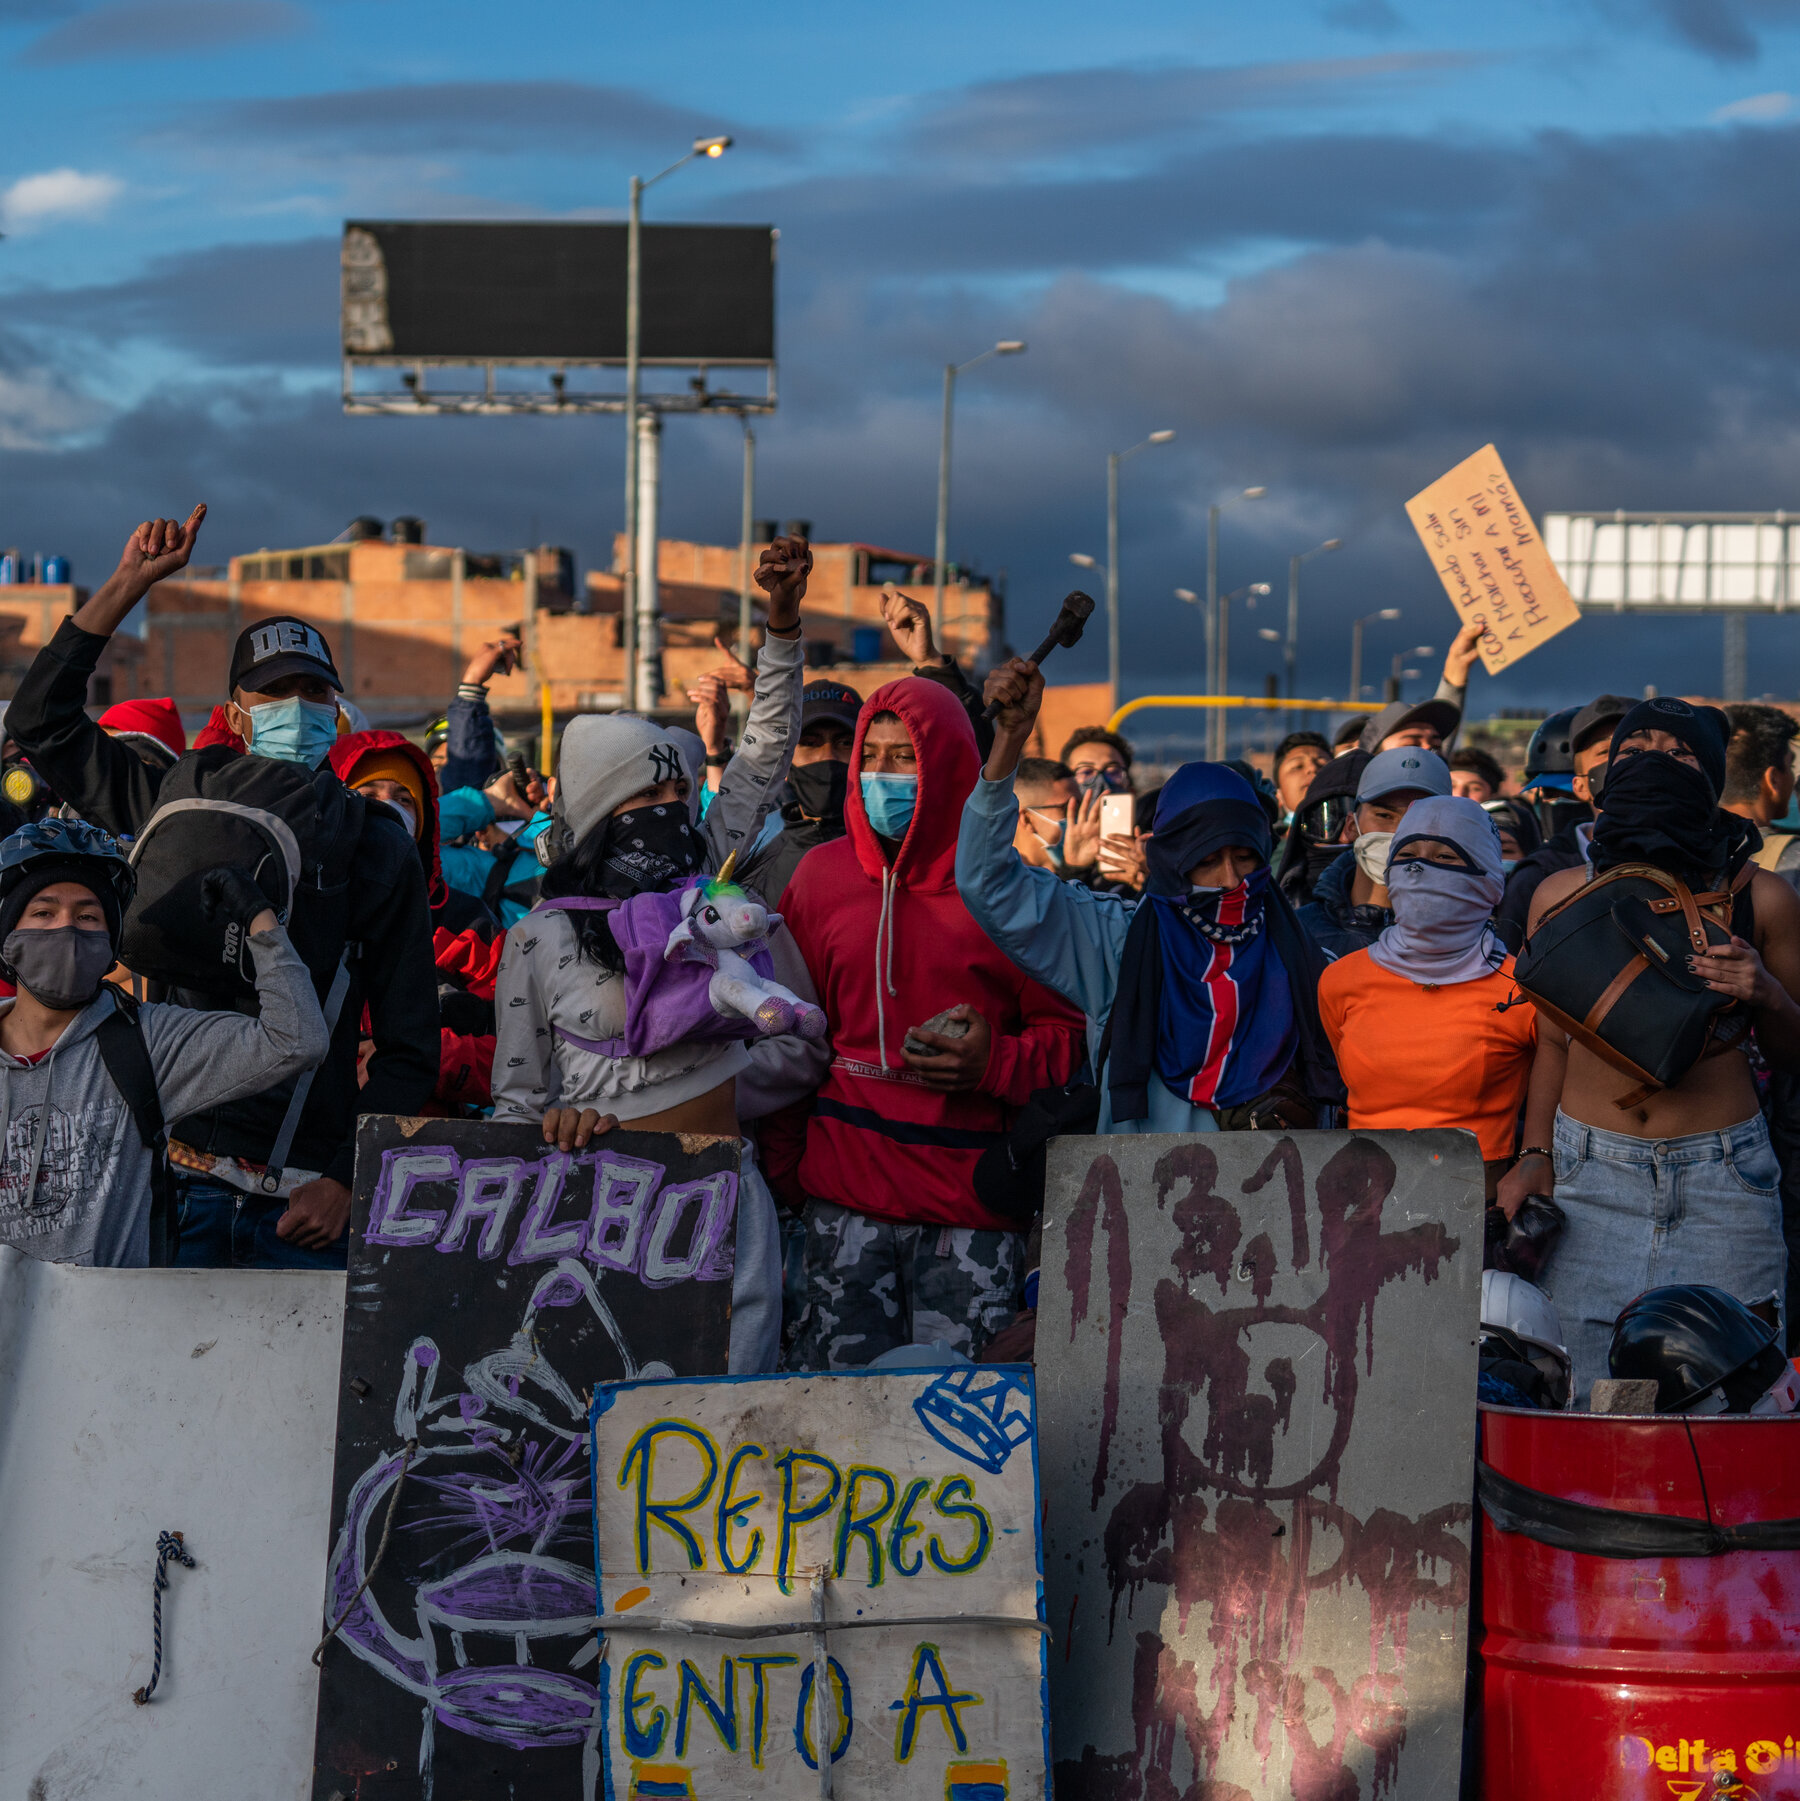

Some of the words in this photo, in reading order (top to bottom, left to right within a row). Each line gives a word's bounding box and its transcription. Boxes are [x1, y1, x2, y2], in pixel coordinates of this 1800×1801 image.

[1485, 522, 1499, 536] A
[1494, 546, 1549, 627] Preocupar
[250, 622, 330, 665] DEA
[1507, 626, 1525, 640] A
[803, 688, 840, 702] ebok
[648, 743, 684, 784] NY
[222, 921, 240, 964] TOTTO
[362, 1145, 738, 1290] CALBO
[621, 1647, 853, 1771] ENTO
[889, 1641, 985, 1764] A
[1619, 1734, 1738, 1774] Delta
